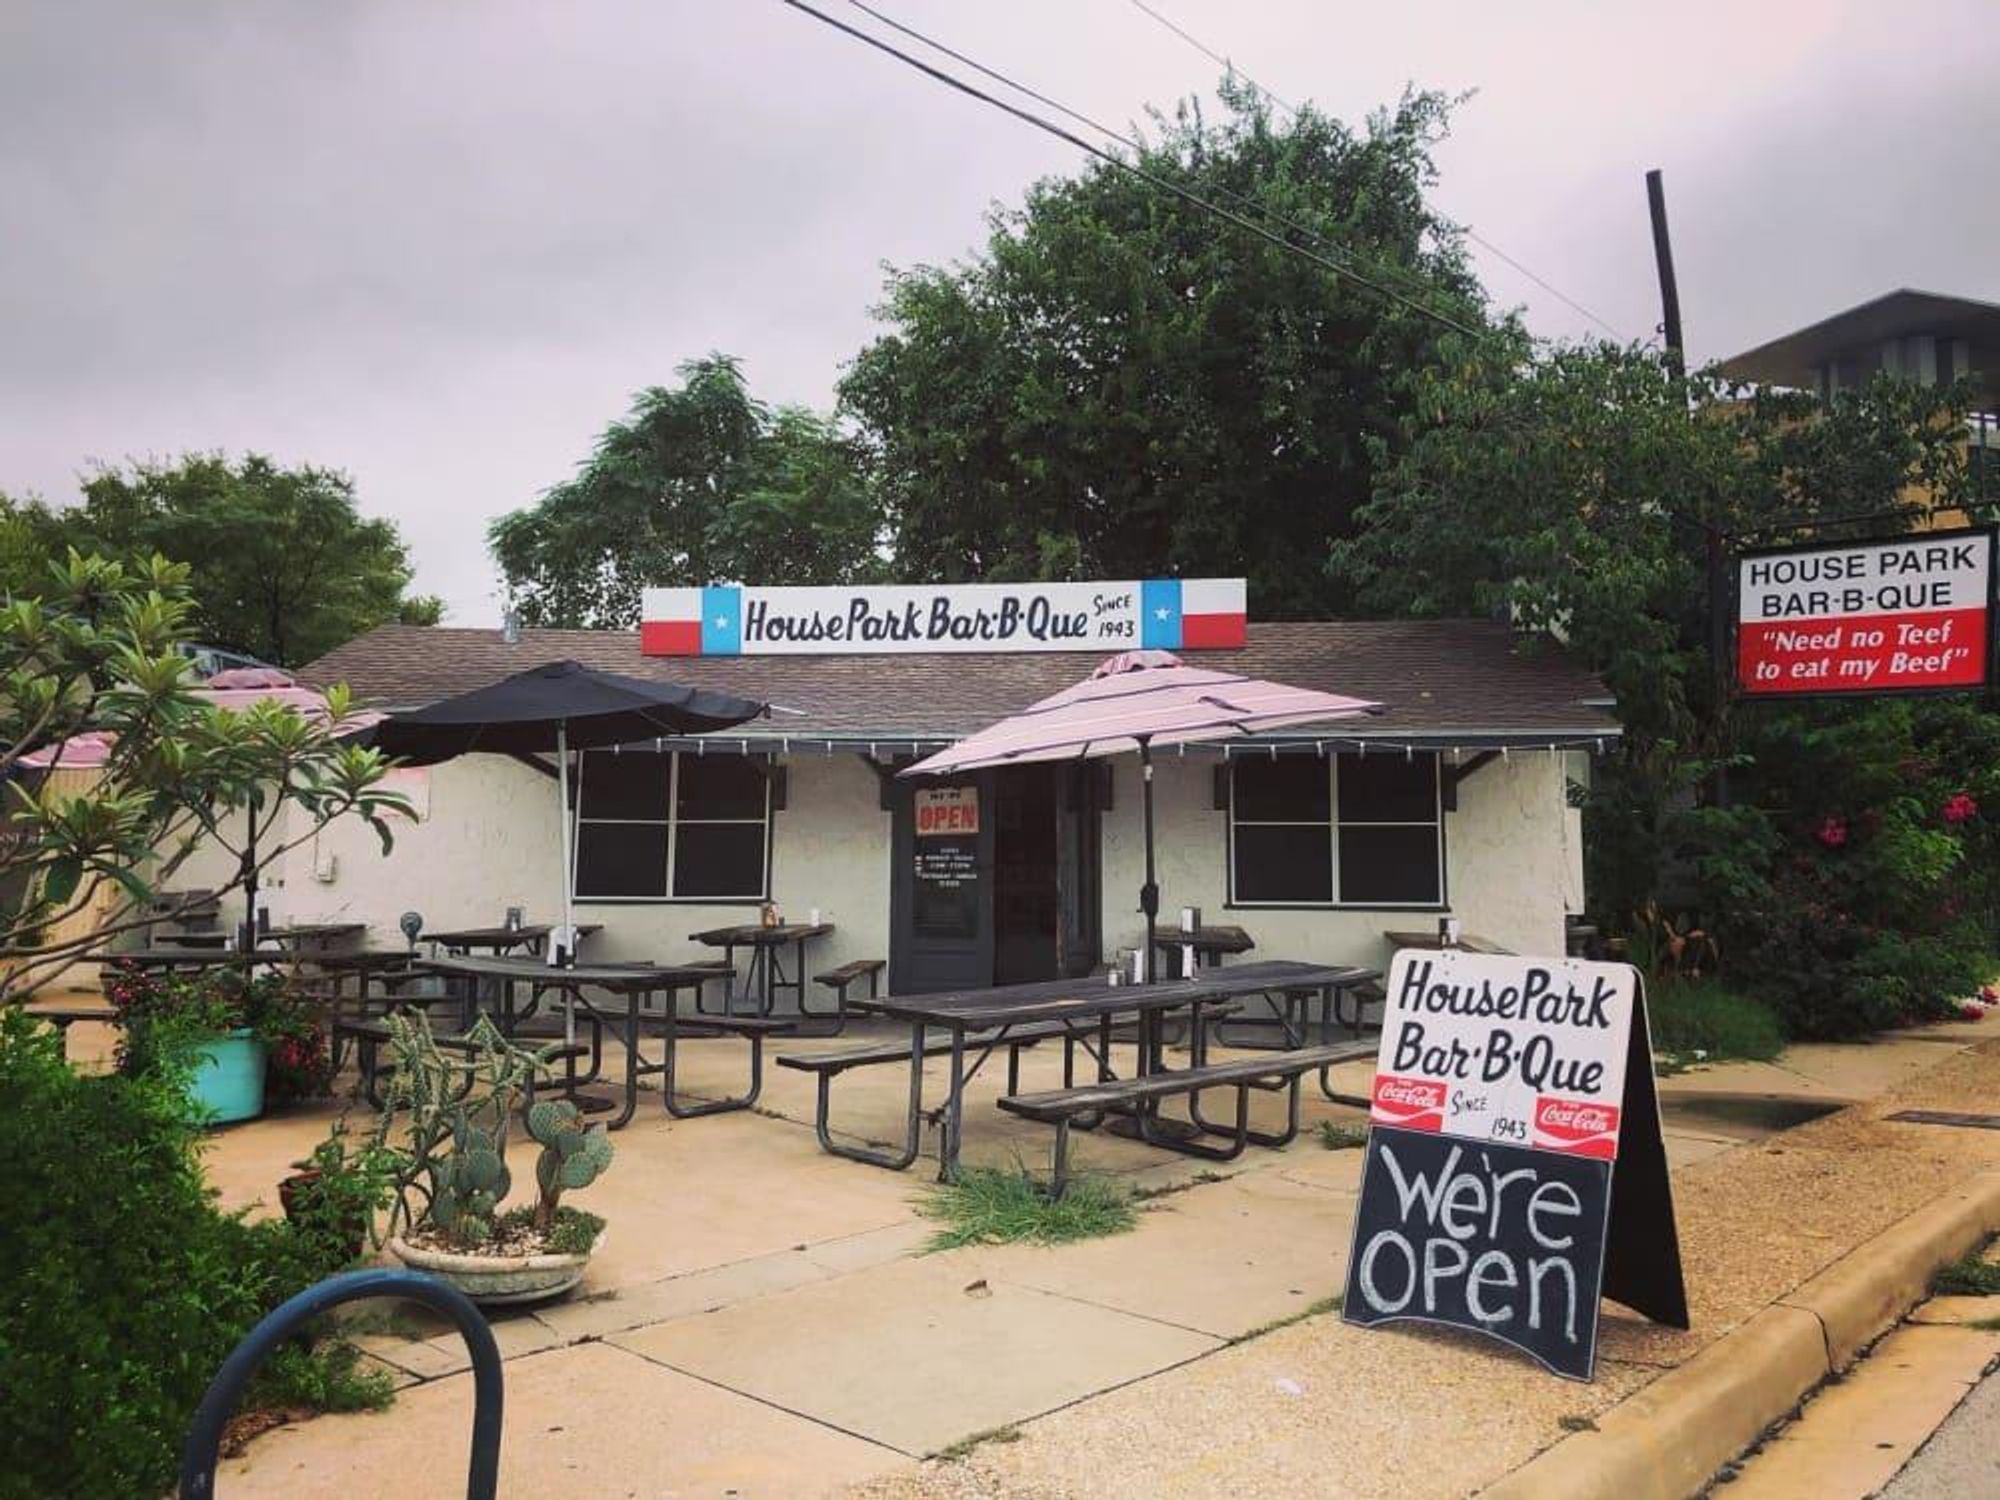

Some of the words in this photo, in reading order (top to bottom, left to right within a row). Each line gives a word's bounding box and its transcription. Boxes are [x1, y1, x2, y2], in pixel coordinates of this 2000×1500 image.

[1750, 554, 1867, 586] HOUSE
[1879, 544, 1976, 576] PARK
[1762, 582, 1953, 617] BAR-B-QUE
[1099, 620, 1135, 638] 1943
[1763, 626, 1842, 652] "Need
[1851, 629, 1884, 648] no
[1897, 619, 1953, 646] Teef
[1755, 660, 1780, 680] to
[1791, 657, 1830, 678] eat
[1838, 658, 1880, 681] my
[1890, 648, 1969, 674] Beef"
[920, 805, 976, 831] OPEN
[1491, 1118, 1527, 1139] 1943
[1379, 1144, 1583, 1249] We're
